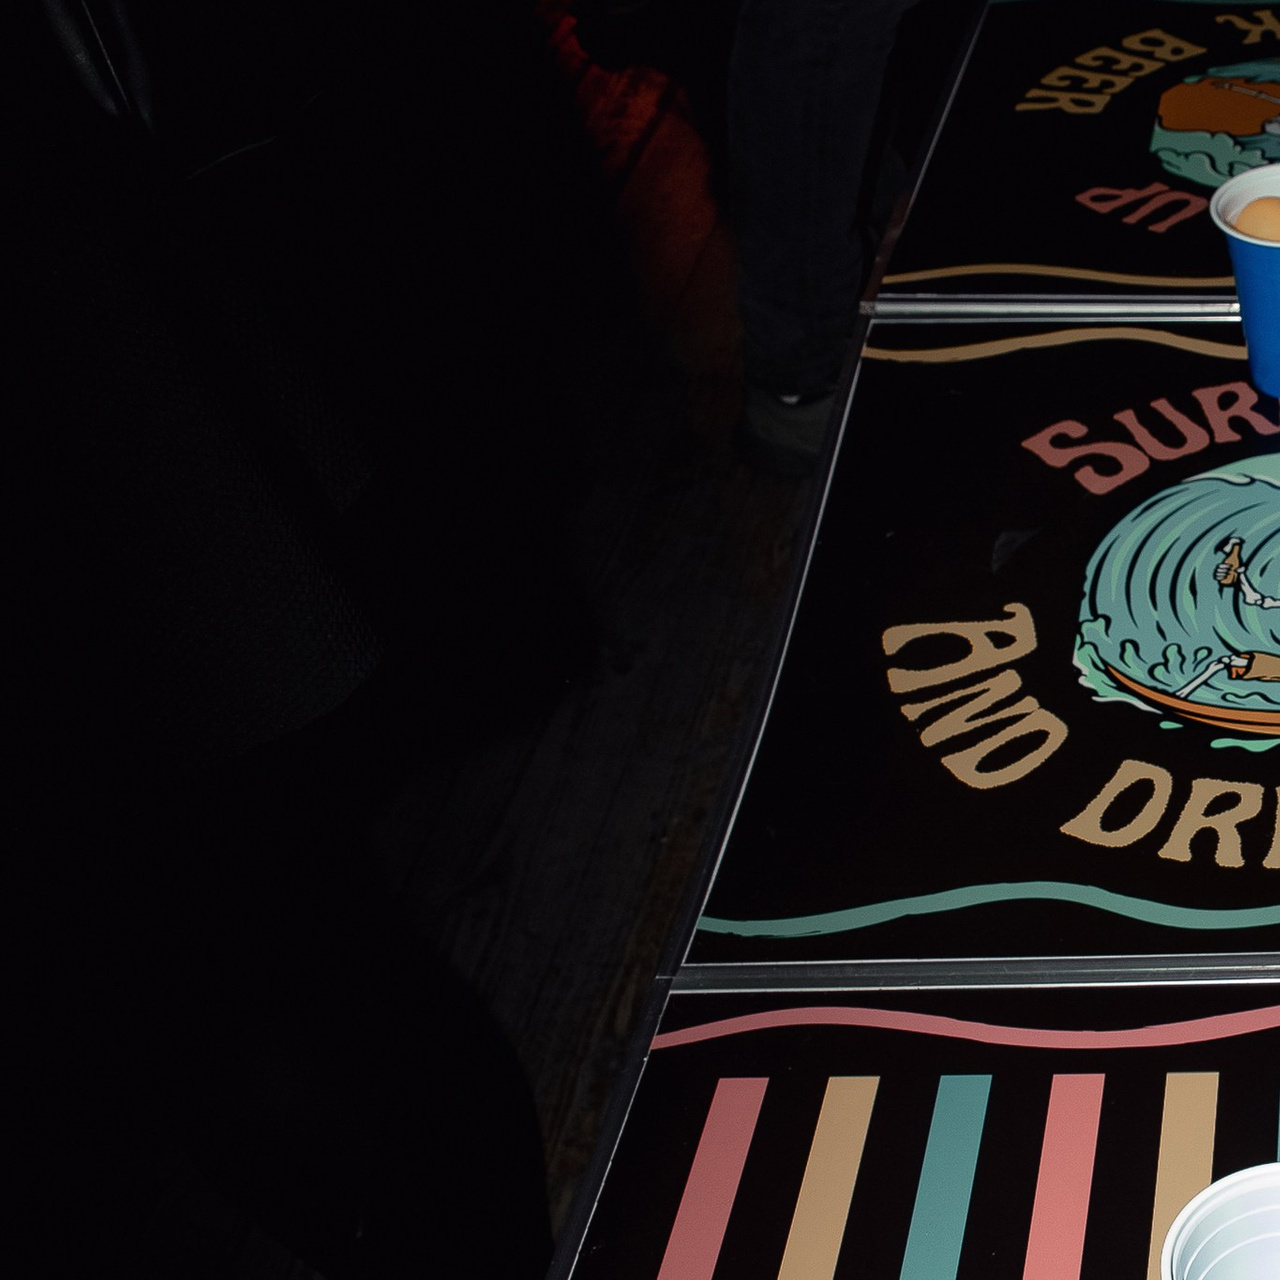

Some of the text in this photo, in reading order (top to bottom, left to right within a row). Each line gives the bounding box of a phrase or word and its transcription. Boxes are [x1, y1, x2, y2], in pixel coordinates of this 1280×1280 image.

[1015, 28, 1207, 114] BEER
[1075, 181, 1209, 233] UP
[881, 602, 1068, 790] AND
